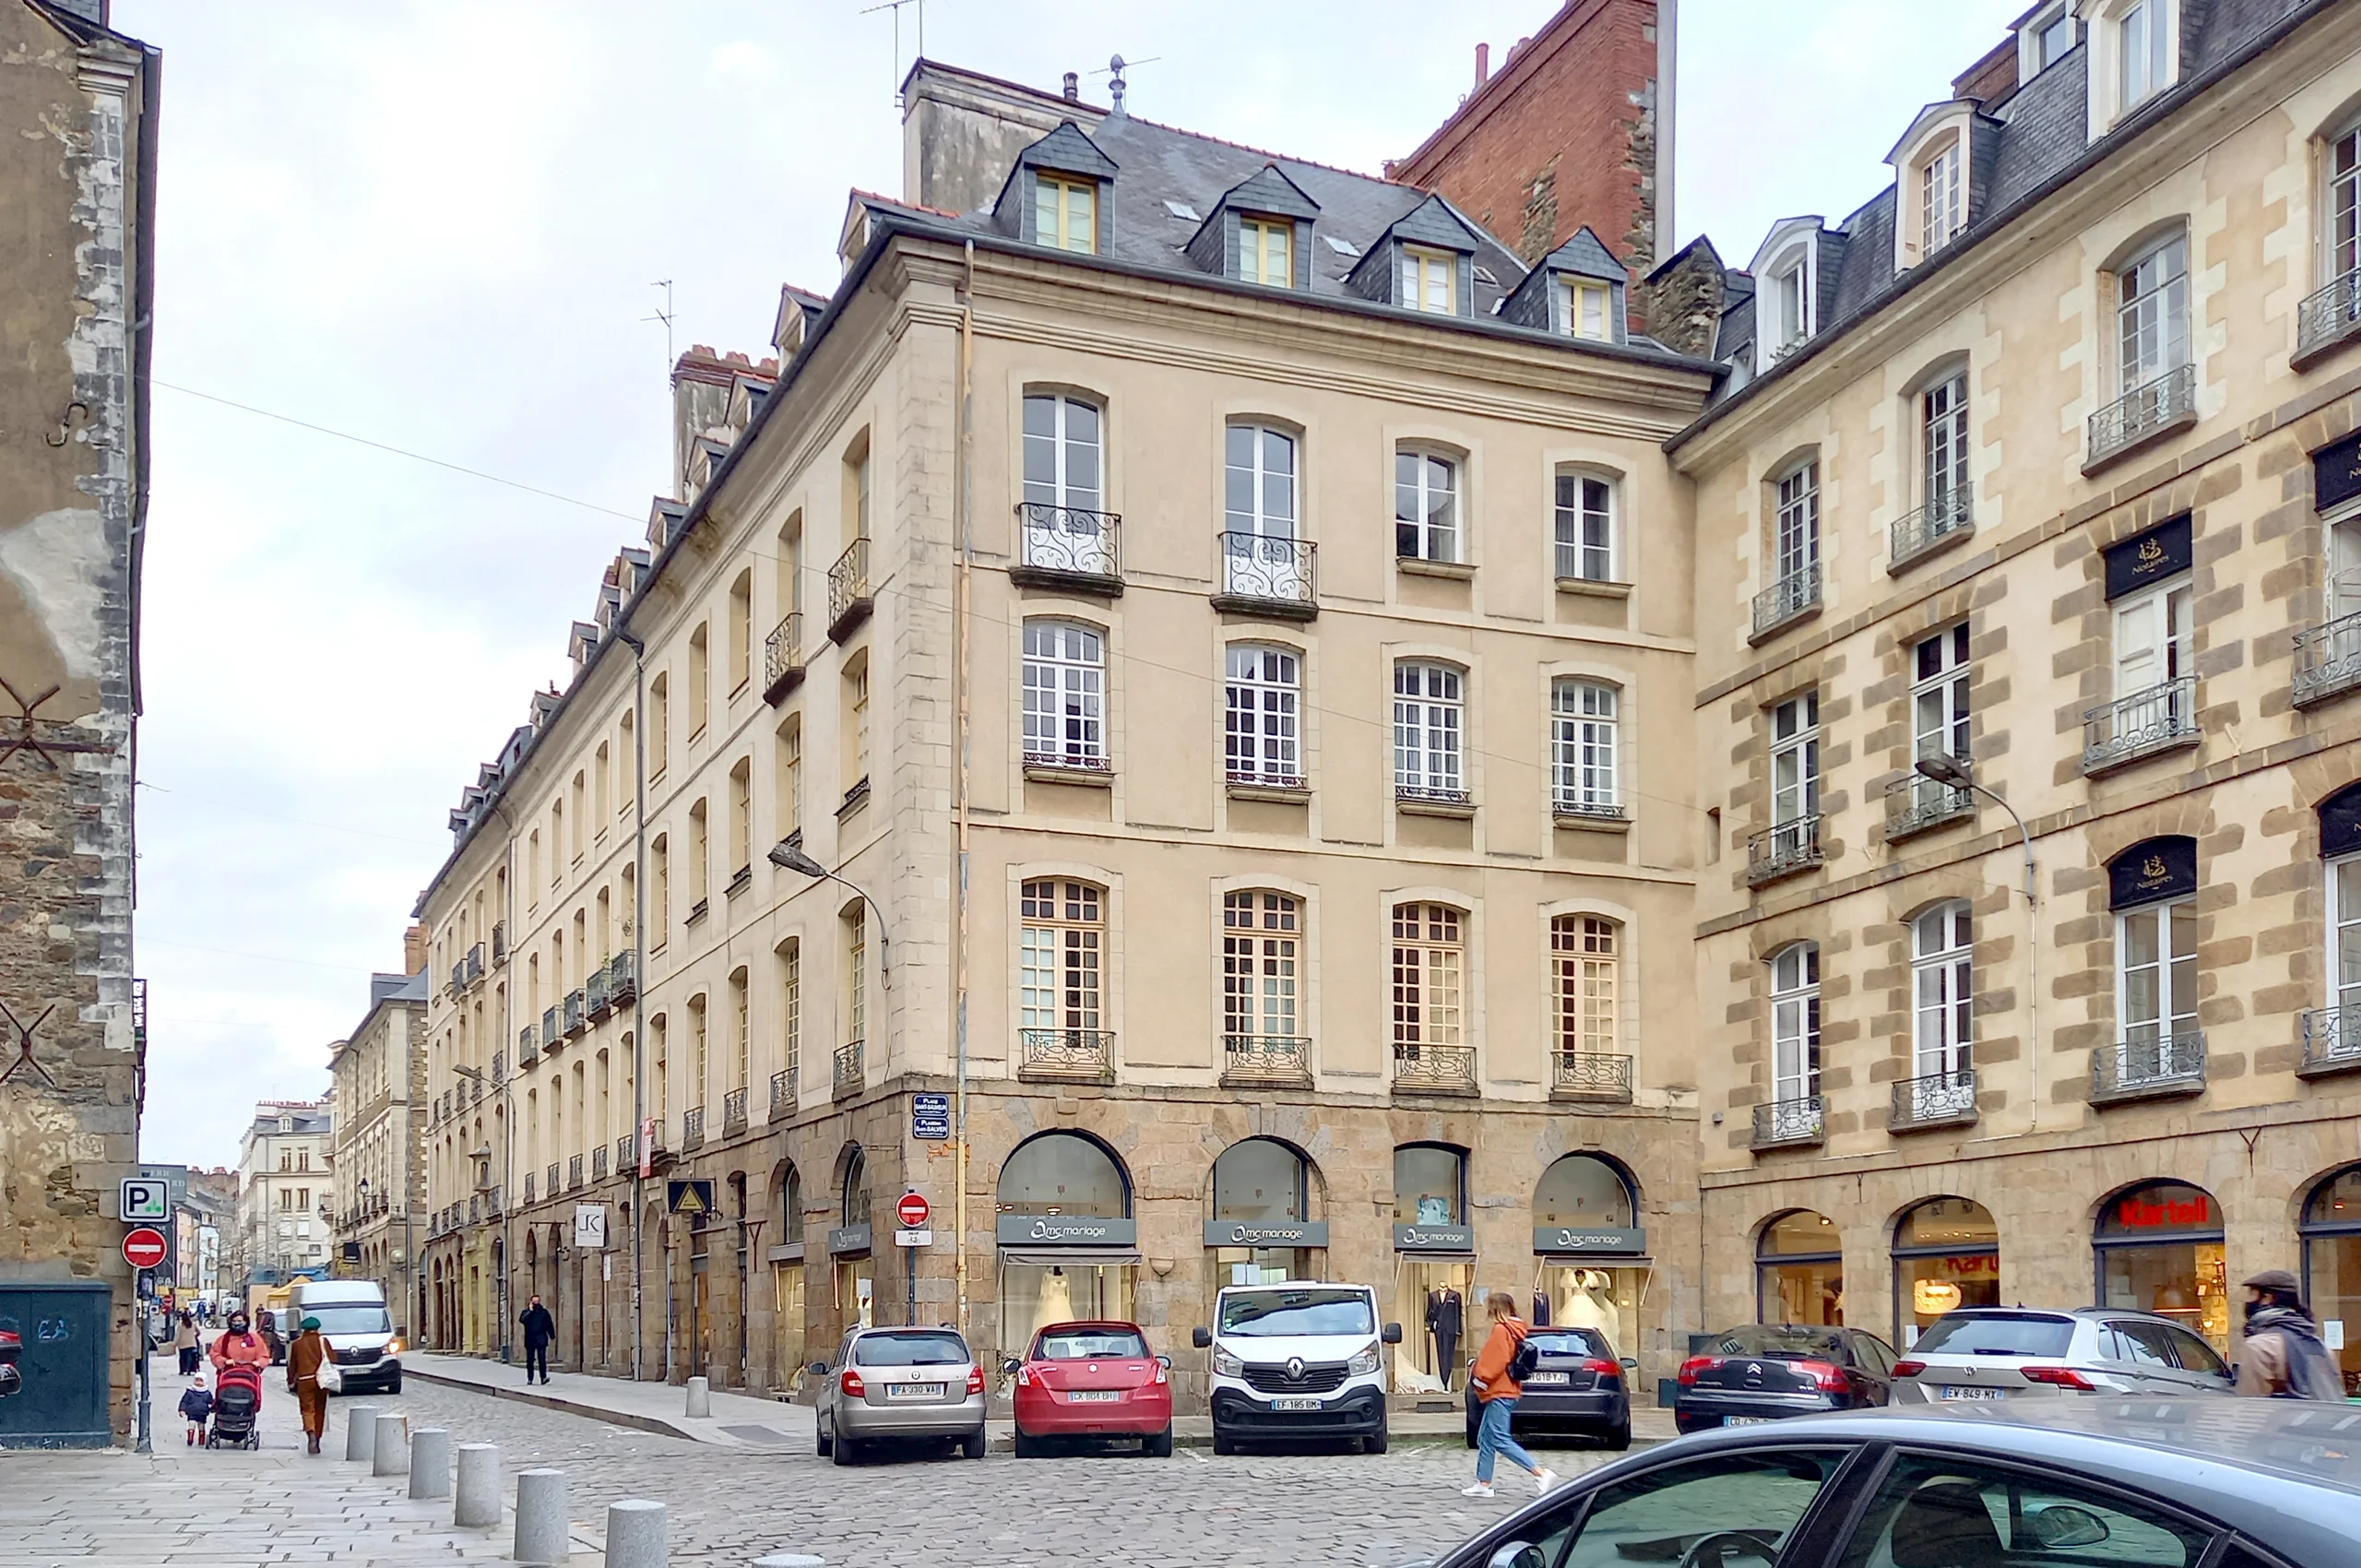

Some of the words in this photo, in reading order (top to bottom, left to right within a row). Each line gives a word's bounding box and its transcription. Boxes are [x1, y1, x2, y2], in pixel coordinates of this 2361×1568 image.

[129, 1187, 149, 1212] P
[2120, 1195, 2207, 1227] Kartell
[1062, 1226, 1106, 1238] mariage
[1262, 1228, 1303, 1240] mariage
[1429, 1232, 1465, 1242] mariage
[1584, 1235, 1622, 1245] mariage
[896, 1384, 935, 1394] FA-330-VA
